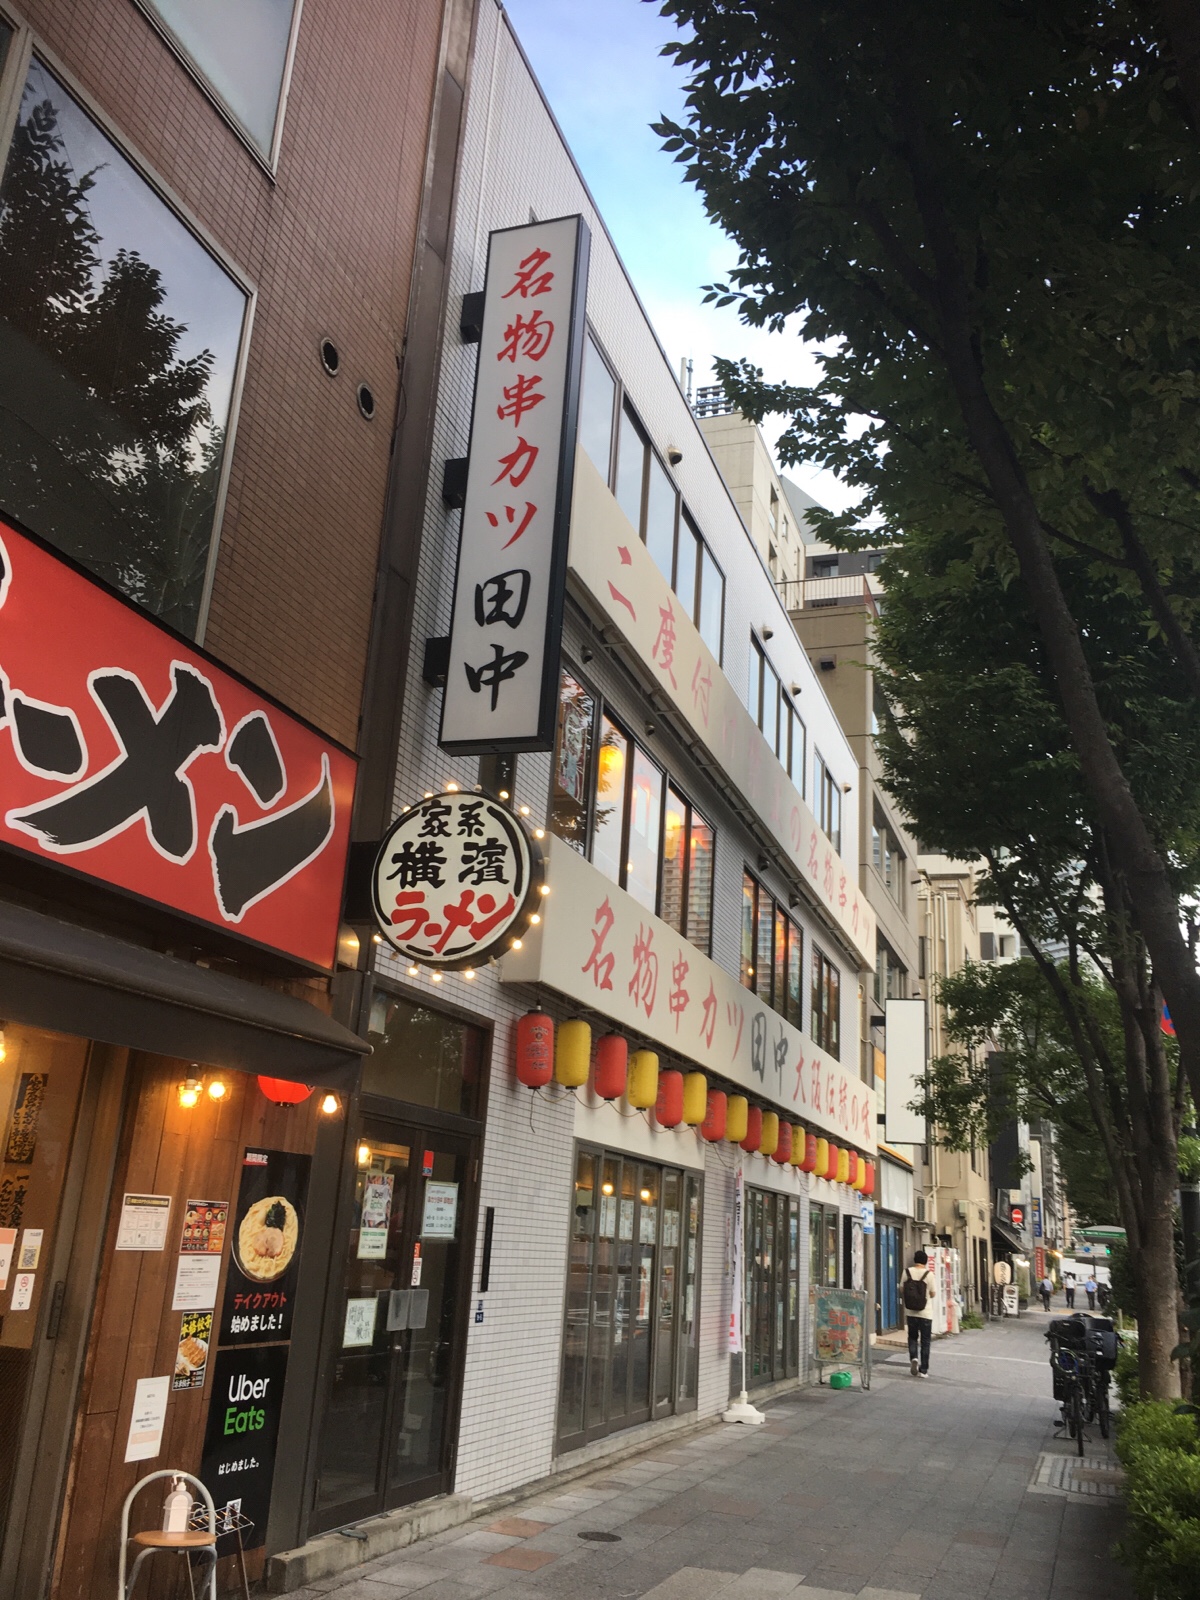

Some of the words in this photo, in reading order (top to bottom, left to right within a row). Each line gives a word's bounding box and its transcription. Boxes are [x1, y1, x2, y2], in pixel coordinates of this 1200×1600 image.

[463, 247, 554, 712] 名物串カツ田中
[0, 535, 336, 924] ーメン
[417, 800, 486, 838] 家系
[386, 837, 510, 890] 横濱
[390, 889, 516, 954] ラーメン
[234, 1292, 287, 1310] テイクアウト
[228, 1374, 270, 1403] Uber
[223, 1405, 266, 1436] Eats
[218, 1457, 260, 1476] はじめました。
